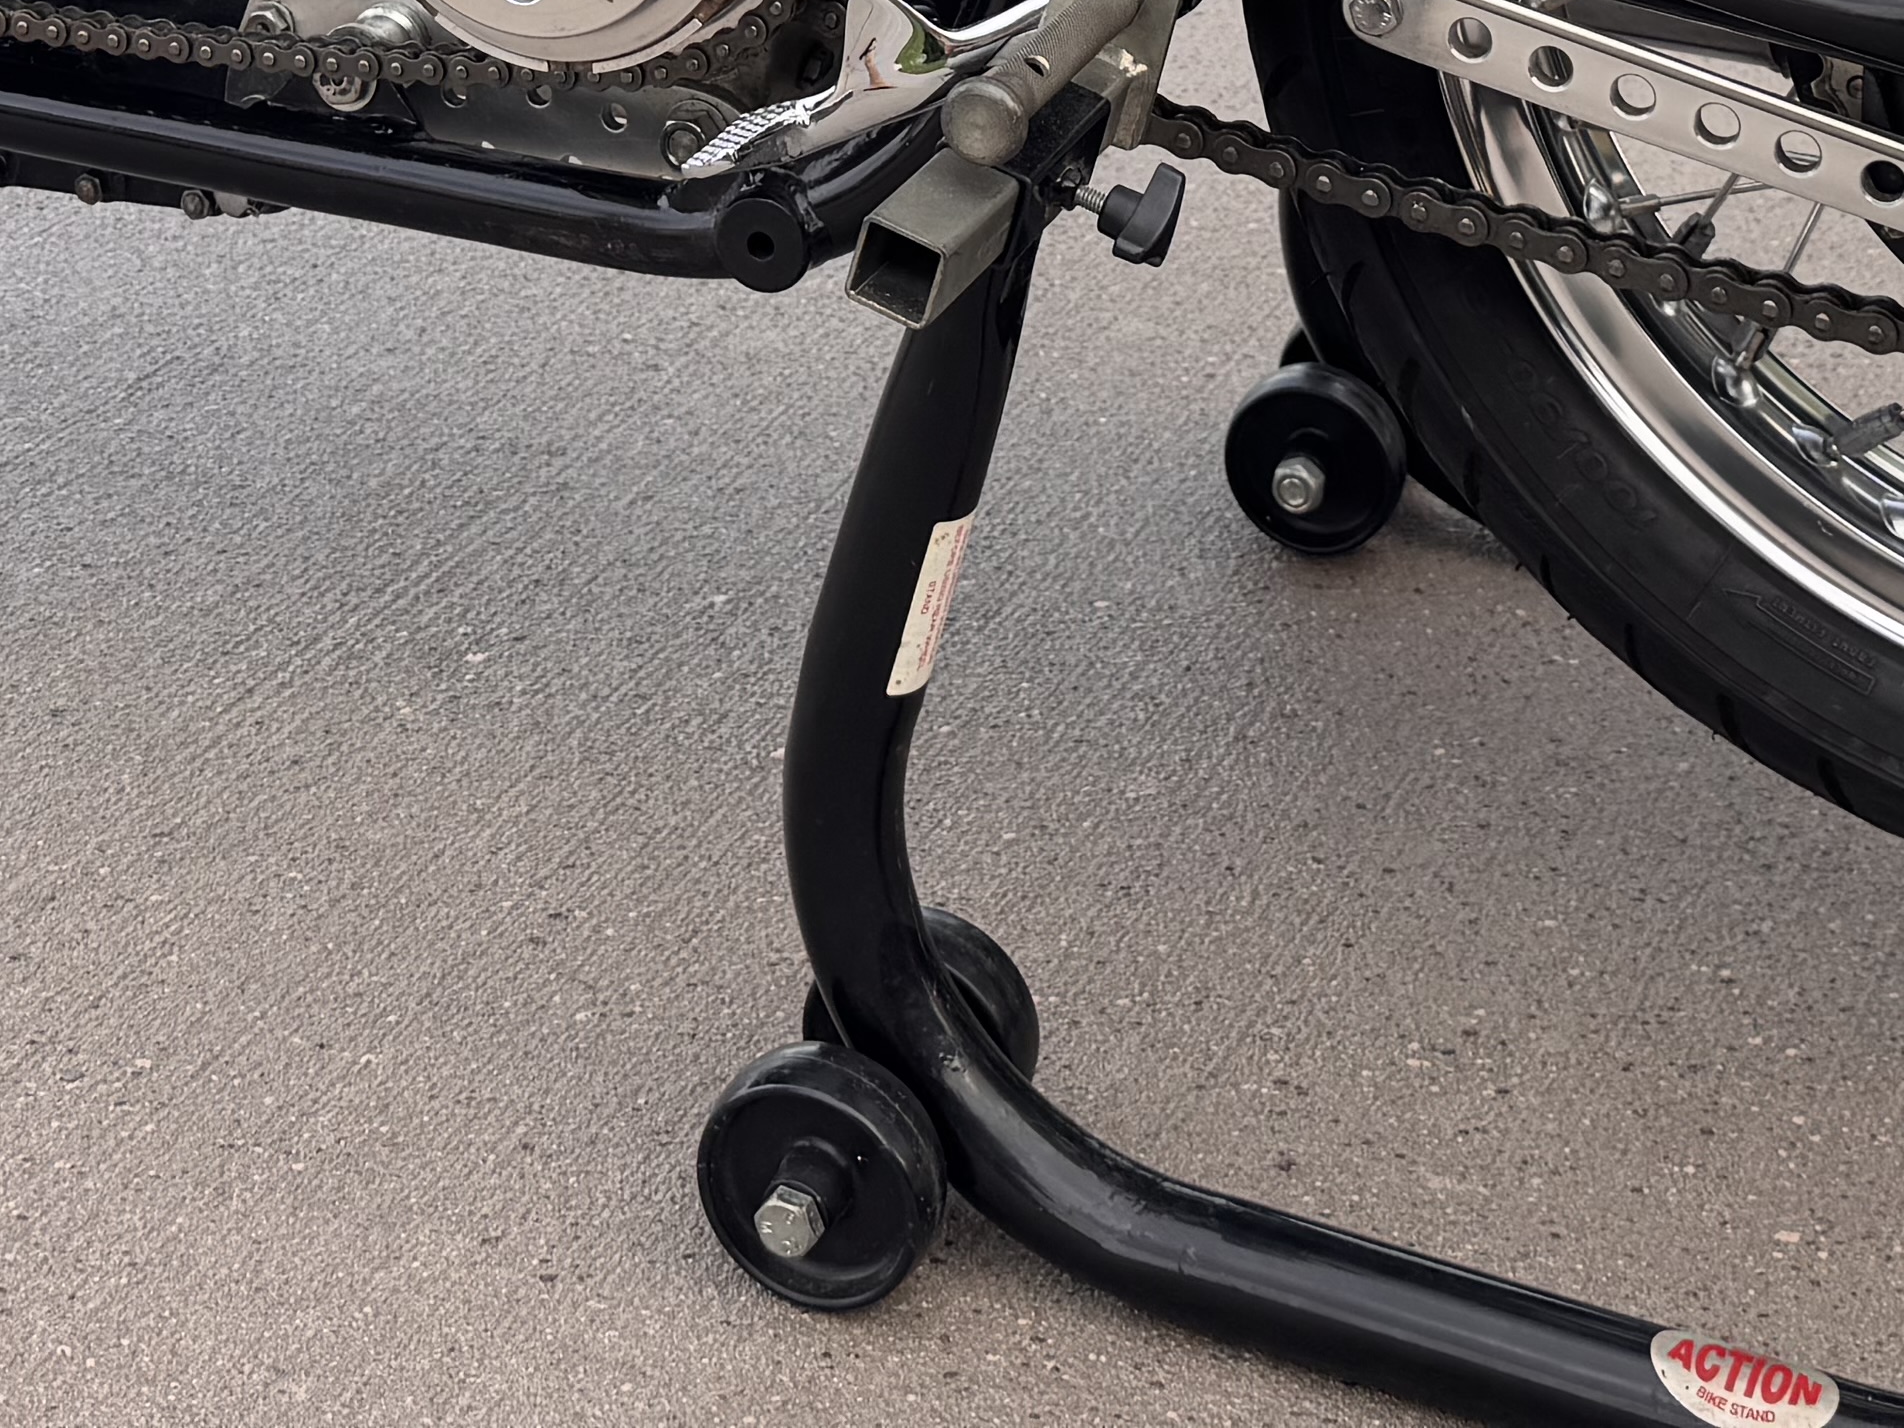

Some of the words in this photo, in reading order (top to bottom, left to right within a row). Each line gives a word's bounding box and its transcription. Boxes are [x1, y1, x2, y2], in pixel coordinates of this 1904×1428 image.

[1667, 1339, 1823, 1406] ACTION
[1696, 1386, 1728, 1411] BIKE
[1729, 1402, 1776, 1423] STAND
